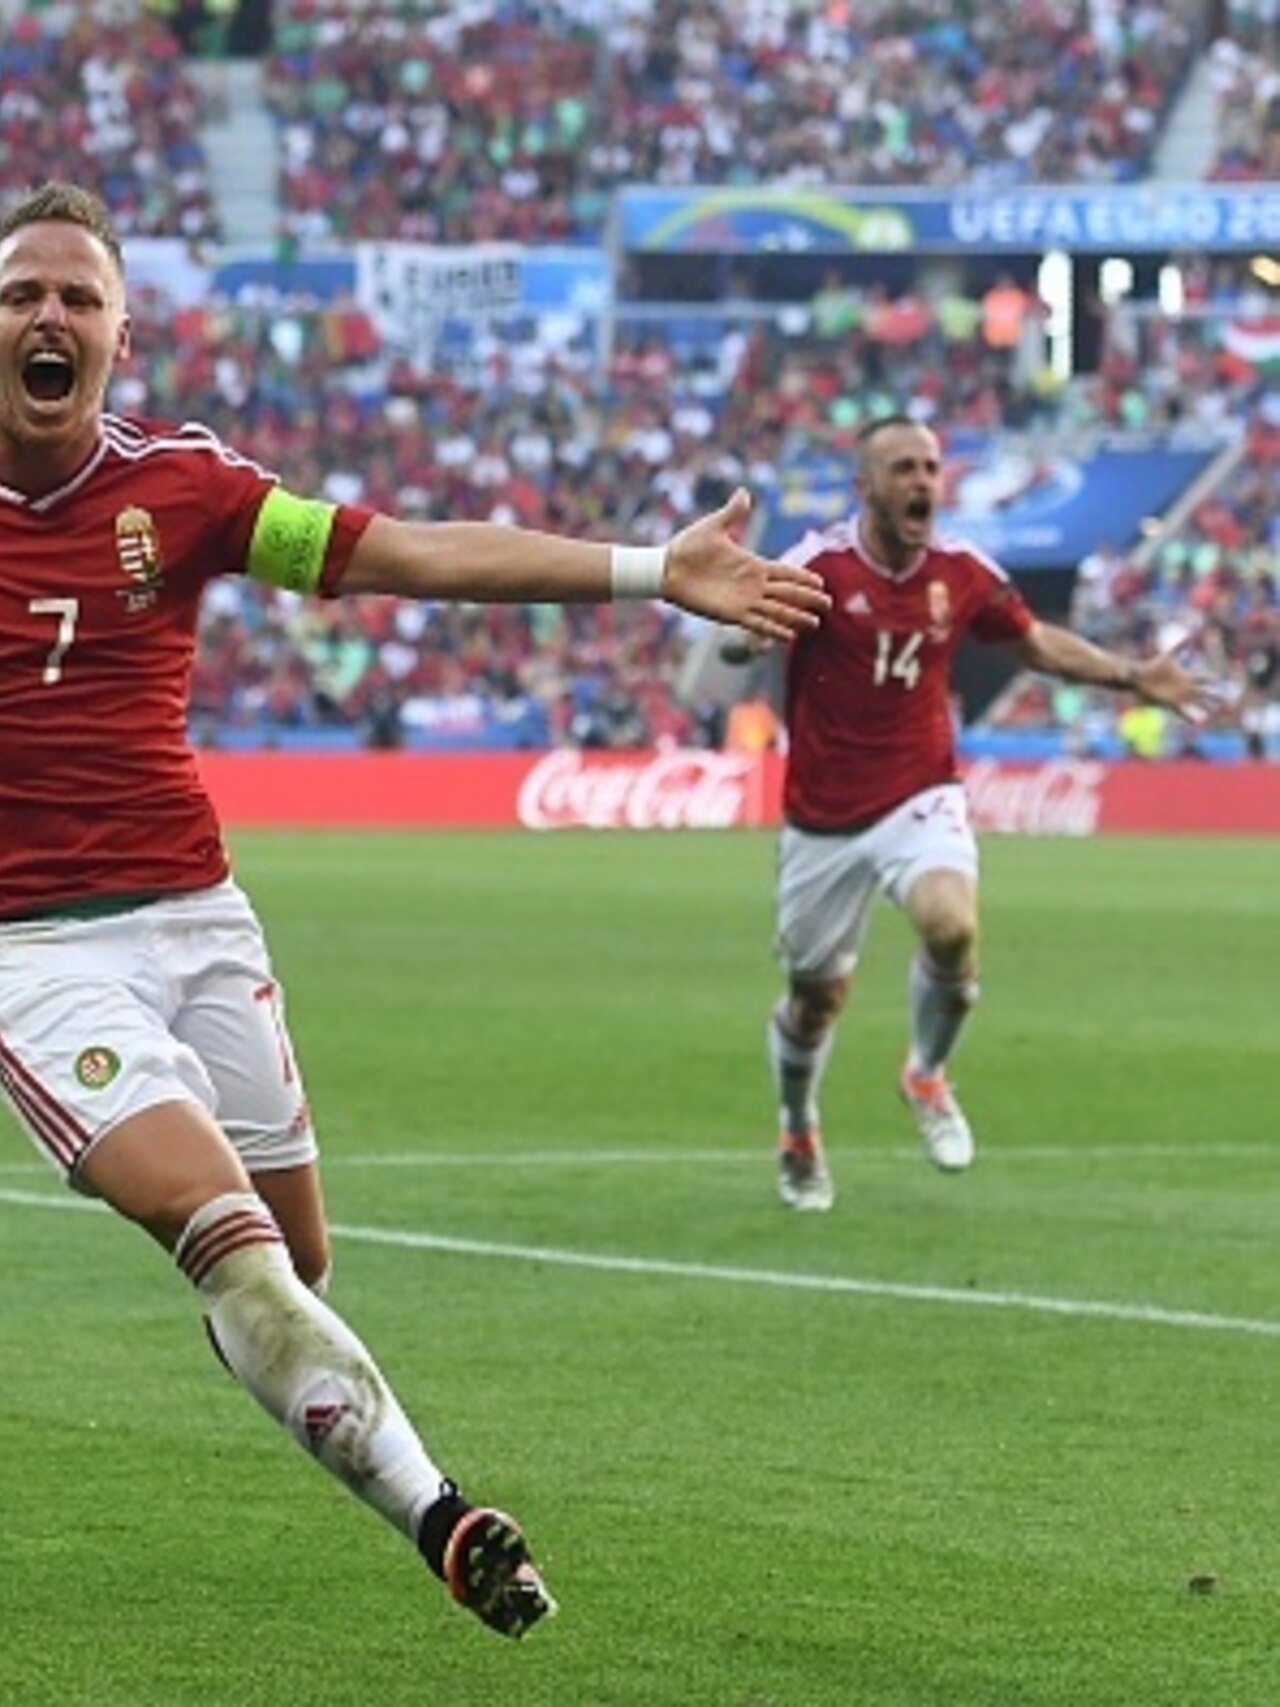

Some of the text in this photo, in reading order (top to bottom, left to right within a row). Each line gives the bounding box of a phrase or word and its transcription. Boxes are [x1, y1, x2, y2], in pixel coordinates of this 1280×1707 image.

[950, 198, 1080, 242] UEFA
[1086, 198, 1220, 242] EURO
[28, 598, 78, 685] 7
[873, 631, 924, 691] 14
[516, 745, 754, 830] Coca-Cola
